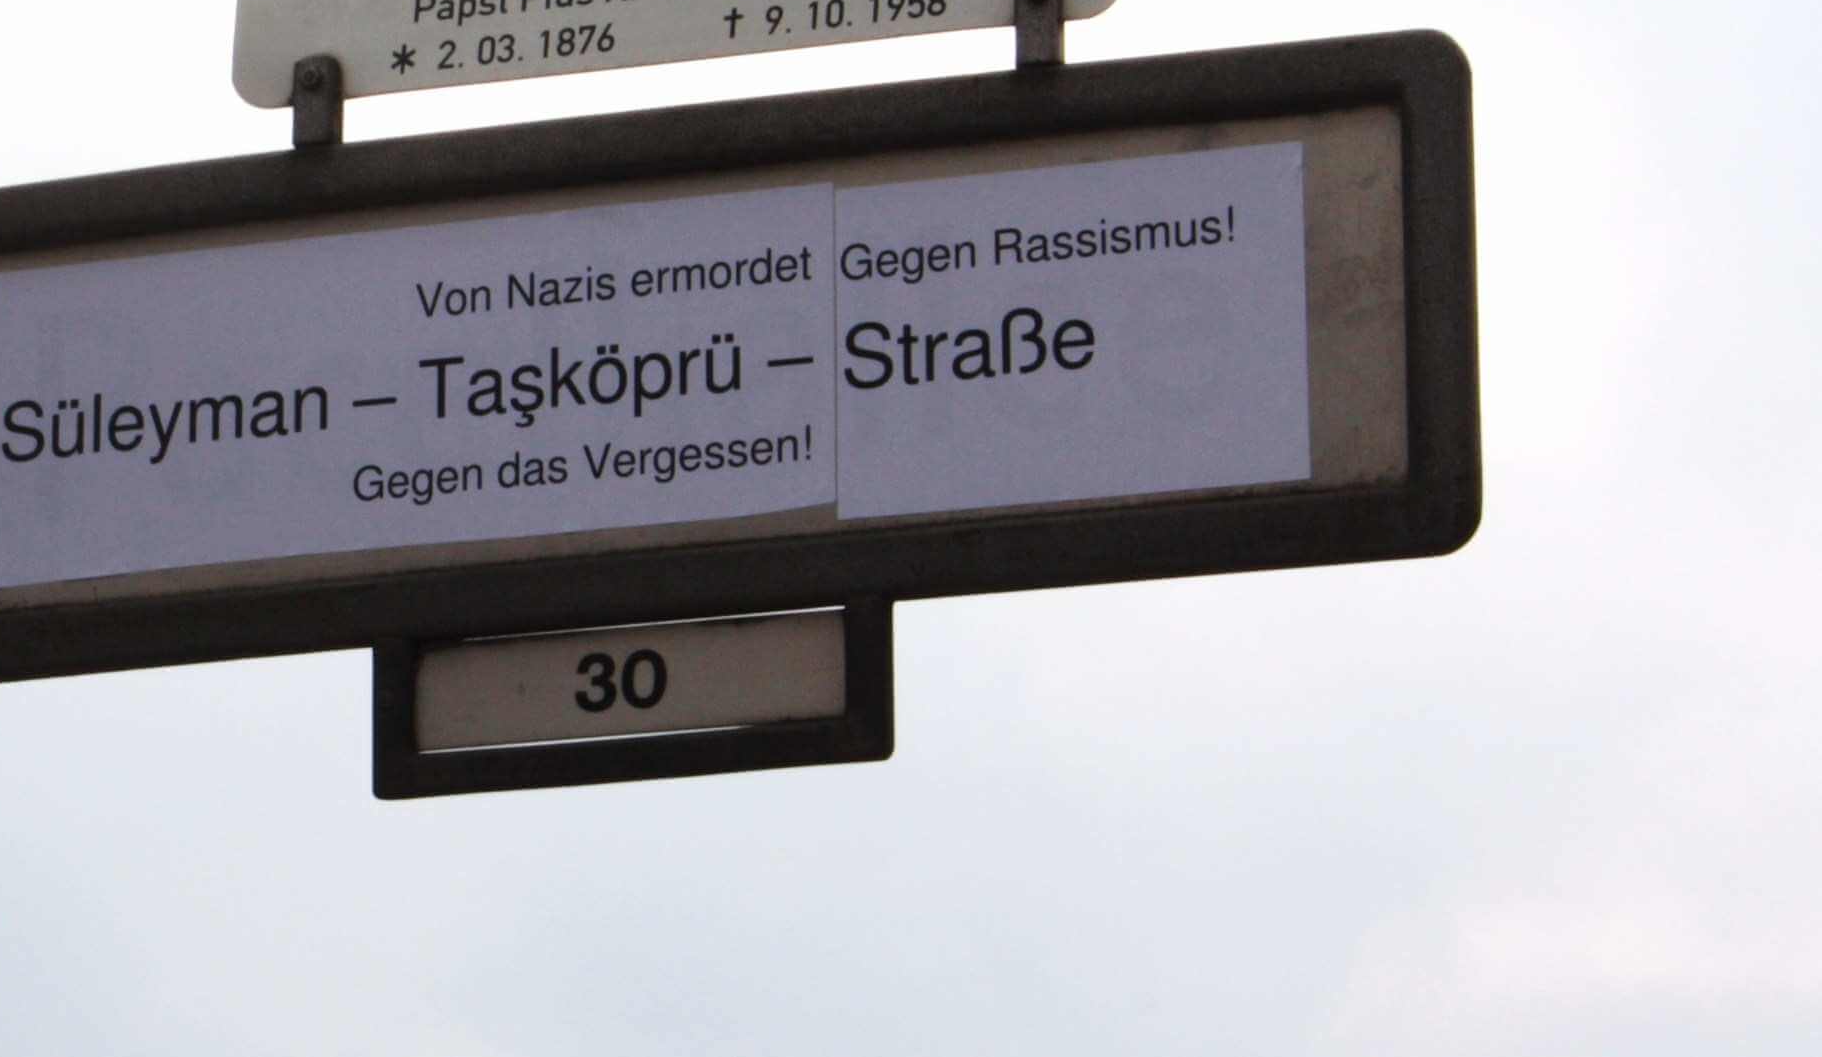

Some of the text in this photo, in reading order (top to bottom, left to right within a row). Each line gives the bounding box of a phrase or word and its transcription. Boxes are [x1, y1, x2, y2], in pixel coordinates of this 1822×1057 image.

[539, 22, 616, 59] 1876
[415, 247, 812, 318] Von Nazis ermordet
[839, 204, 1235, 285] Gegen Rassismus!
[1, 386, 328, 465] Süleyman
[418, 332, 741, 429] Taşköprü
[843, 306, 1096, 390] Straße
[352, 423, 812, 507] Gegen das Vergessen!
[574, 649, 668, 714] 30
